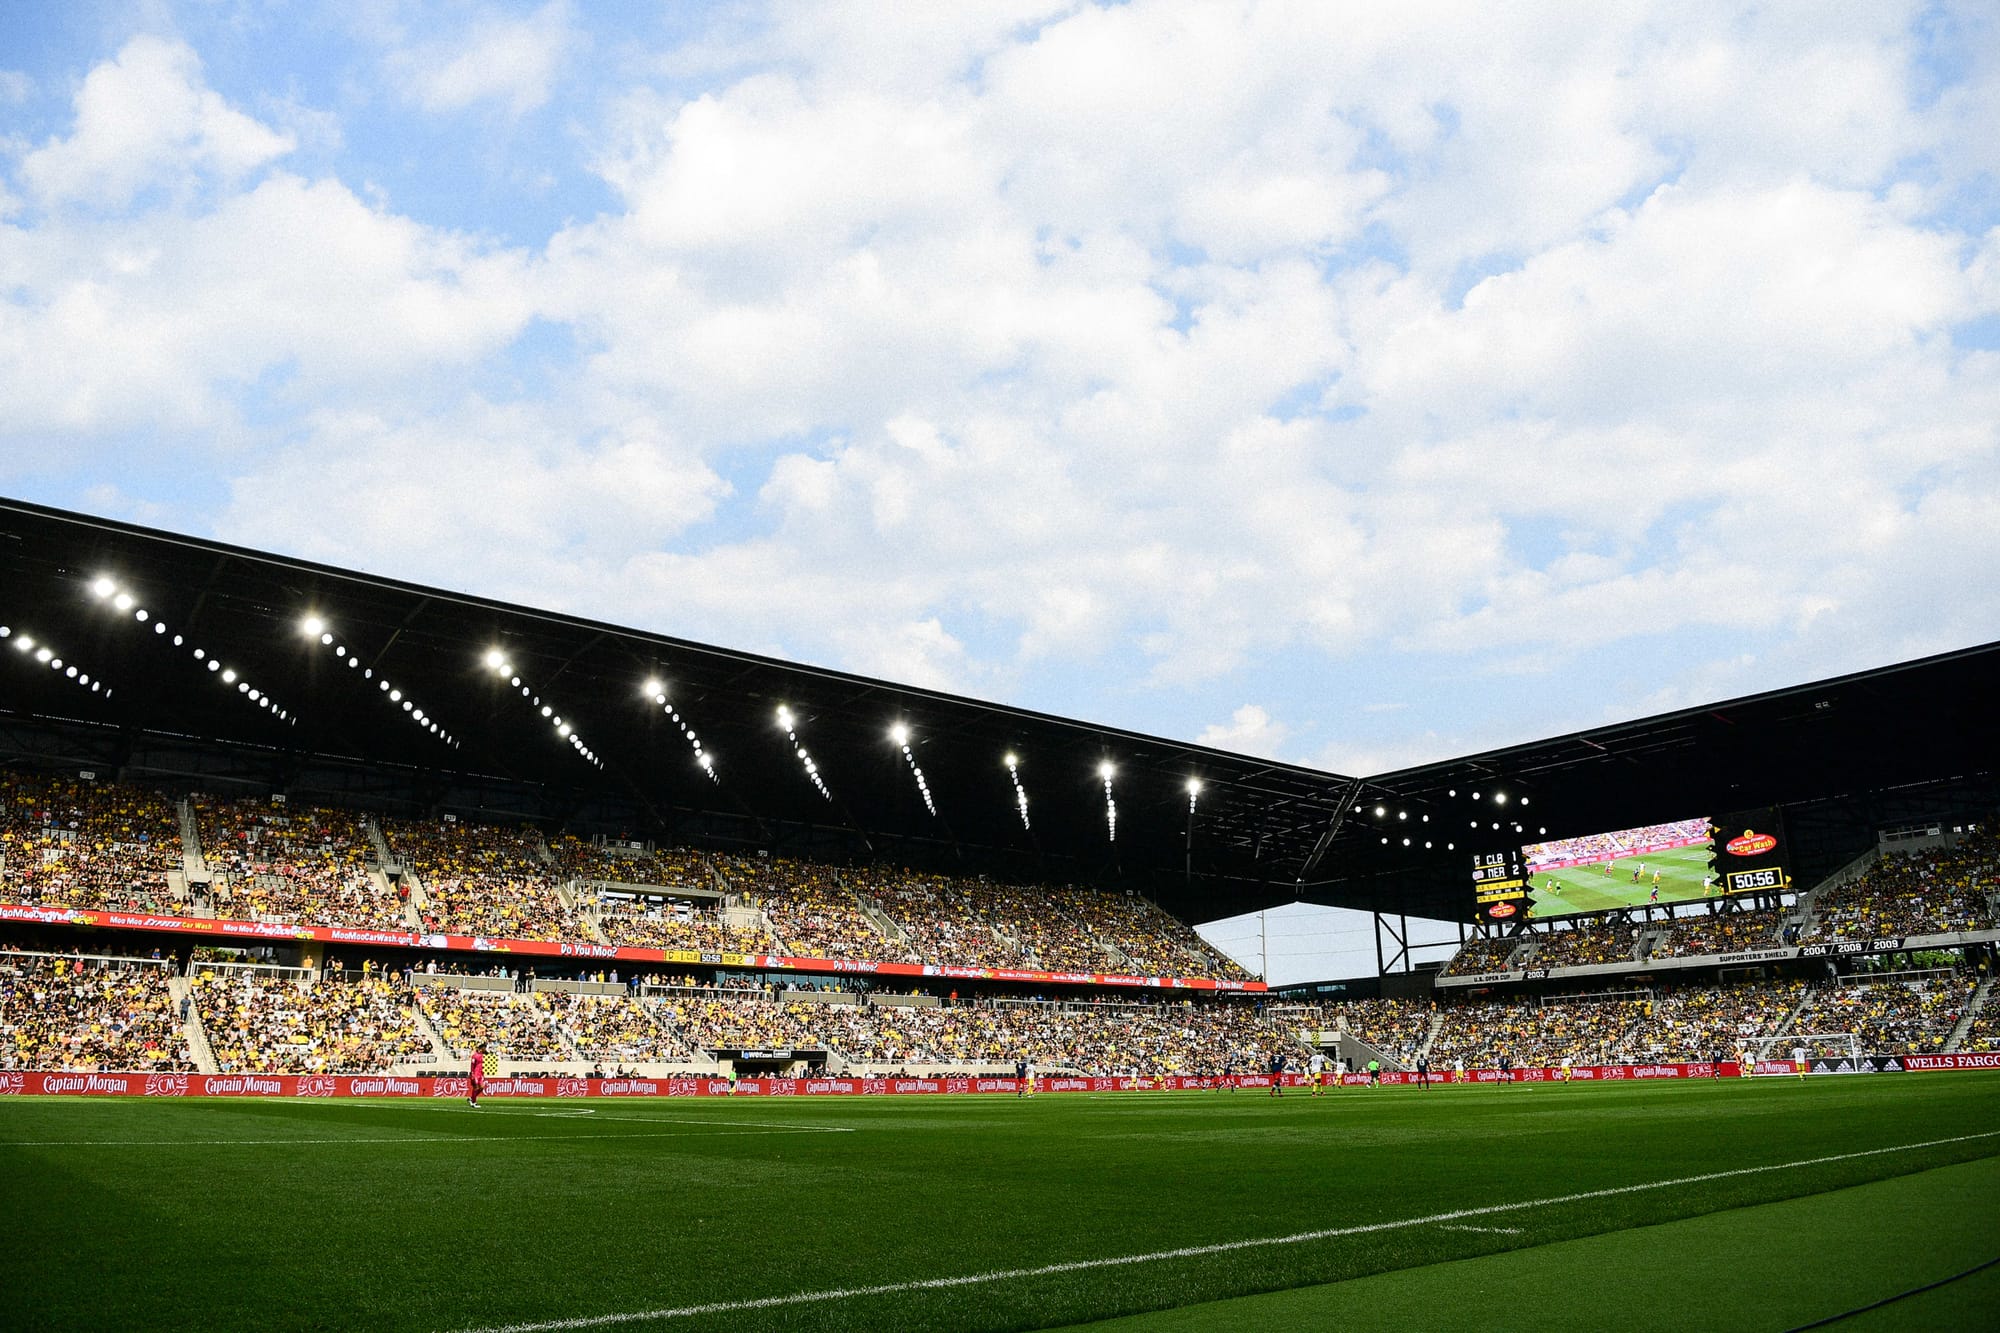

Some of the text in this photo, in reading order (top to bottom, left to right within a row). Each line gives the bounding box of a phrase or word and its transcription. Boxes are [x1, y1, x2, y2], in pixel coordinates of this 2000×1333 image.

[1739, 844, 1752, 853] Car
[1752, 839, 1773, 850] Wash
[1486, 850, 1516, 865] CLB 1
[1487, 864, 1520, 879] NER 2
[1735, 871, 1775, 889] 50:56
[109, 916, 126, 925] Moo
[126, 917, 142, 926] Moo
[195, 922, 213, 931] Wash
[331, 930, 413, 944] MooMooCarWash.com
[560, 943, 618, 957] Do You Moo?
[1719, 952, 1763, 963] SUPPORTERS'
[1803, 947, 1827, 956] 2004
[1837, 943, 1862, 953] 2008
[1873, 939, 1899, 950] 2009
[701, 953, 721, 963] 50:56
[737, 955, 743, 964] 2
[833, 960, 878, 973] Do You Moo?
[1527, 971, 1545, 979] 2002
[1764, 1062, 1791, 1074] Morgan
[1906, 1056, 1954, 1069] WELLS
[1477, 1071, 1496, 1081] Captain
[1633, 1066, 1679, 1078] Captain Morgan
[43, 1074, 127, 1093] Captain Morgan
[205, 1076, 281, 1095] Captain Morgan
[350, 1077, 419, 1095] Captain Morgan
[512, 1081, 544, 1095] Morgan
[601, 1080, 657, 1095] Captain Morgan
[806, 1081, 853, 1095] Captain Morgan
[895, 1080, 938, 1093] Captain Morgan
[976, 1080, 1016, 1093] Captain Morgan
[1051, 1079, 1087, 1090] Captain Morgan
